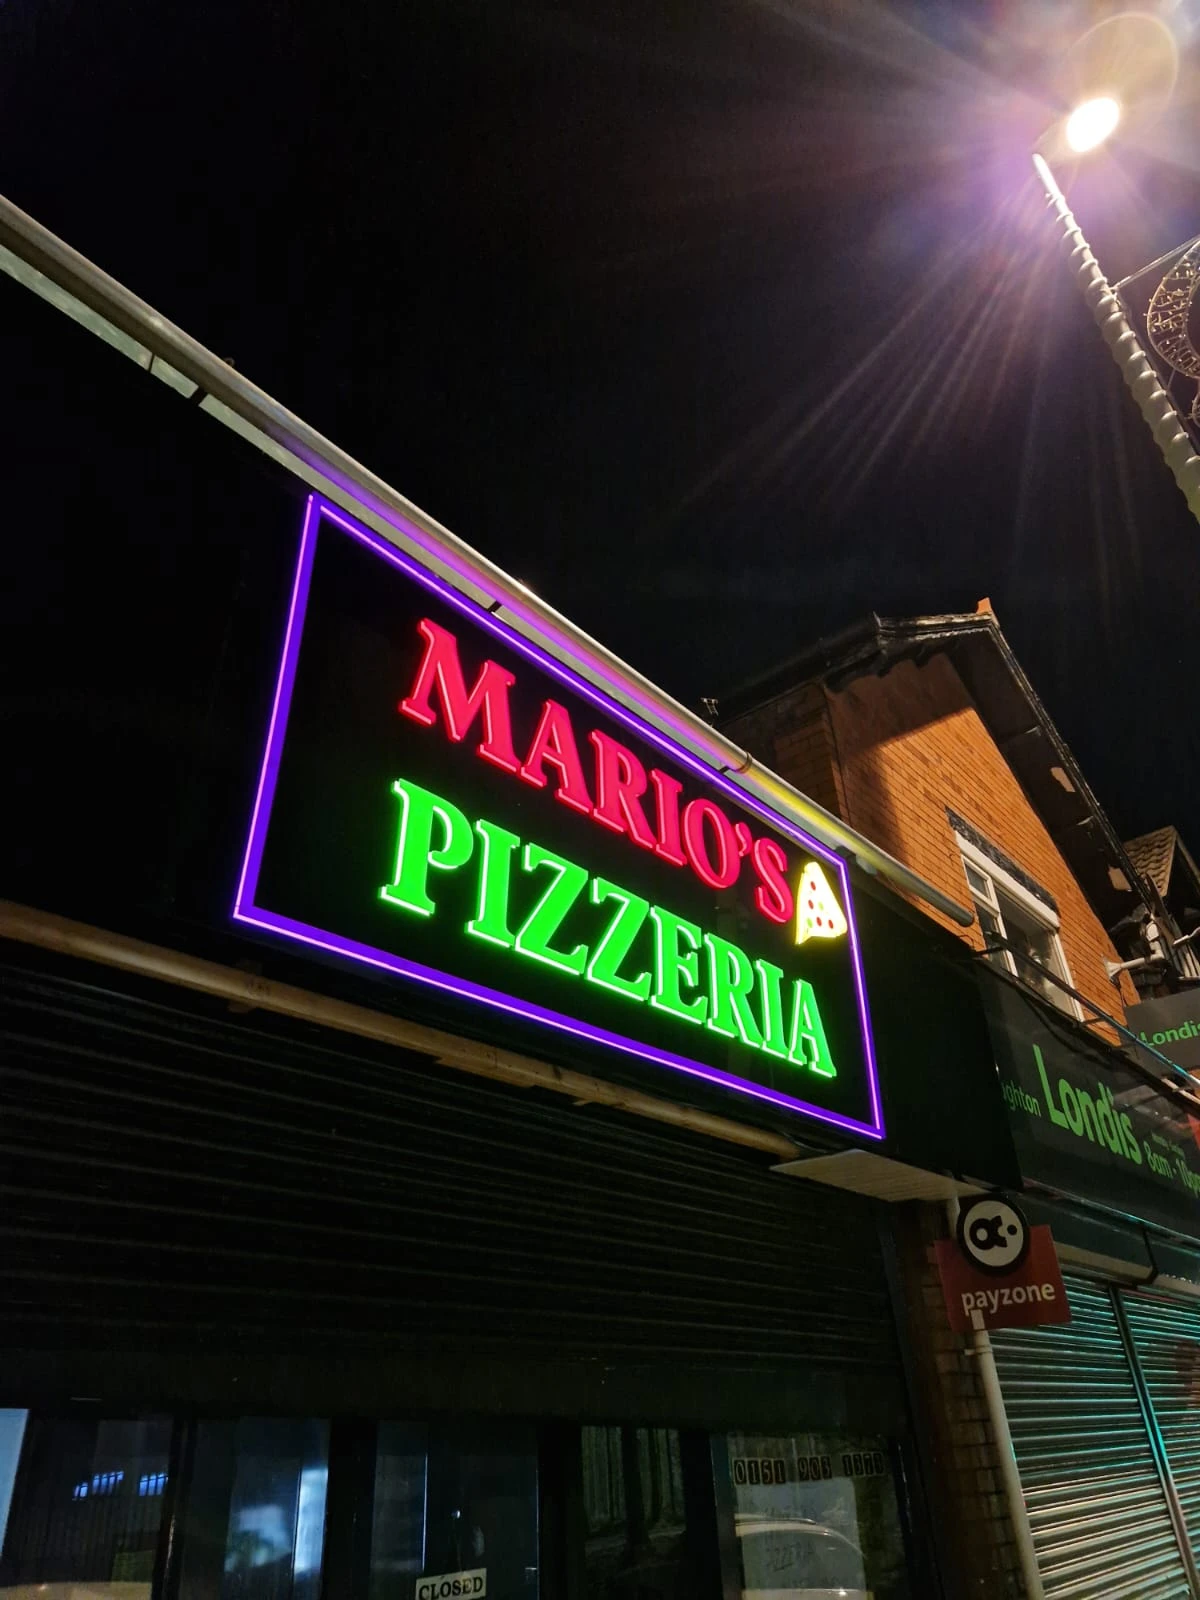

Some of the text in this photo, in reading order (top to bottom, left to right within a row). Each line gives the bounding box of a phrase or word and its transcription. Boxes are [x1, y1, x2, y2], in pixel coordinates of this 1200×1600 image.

[401, 617, 794, 925] MARIO'S
[379, 777, 837, 1079] PIZZERIA
[1032, 1043, 1143, 1166] Londis
[961, 1282, 1057, 1318] payzone
[734, 1458, 787, 1484] 0151
[419, 1576, 483, 1600] CLOSED
